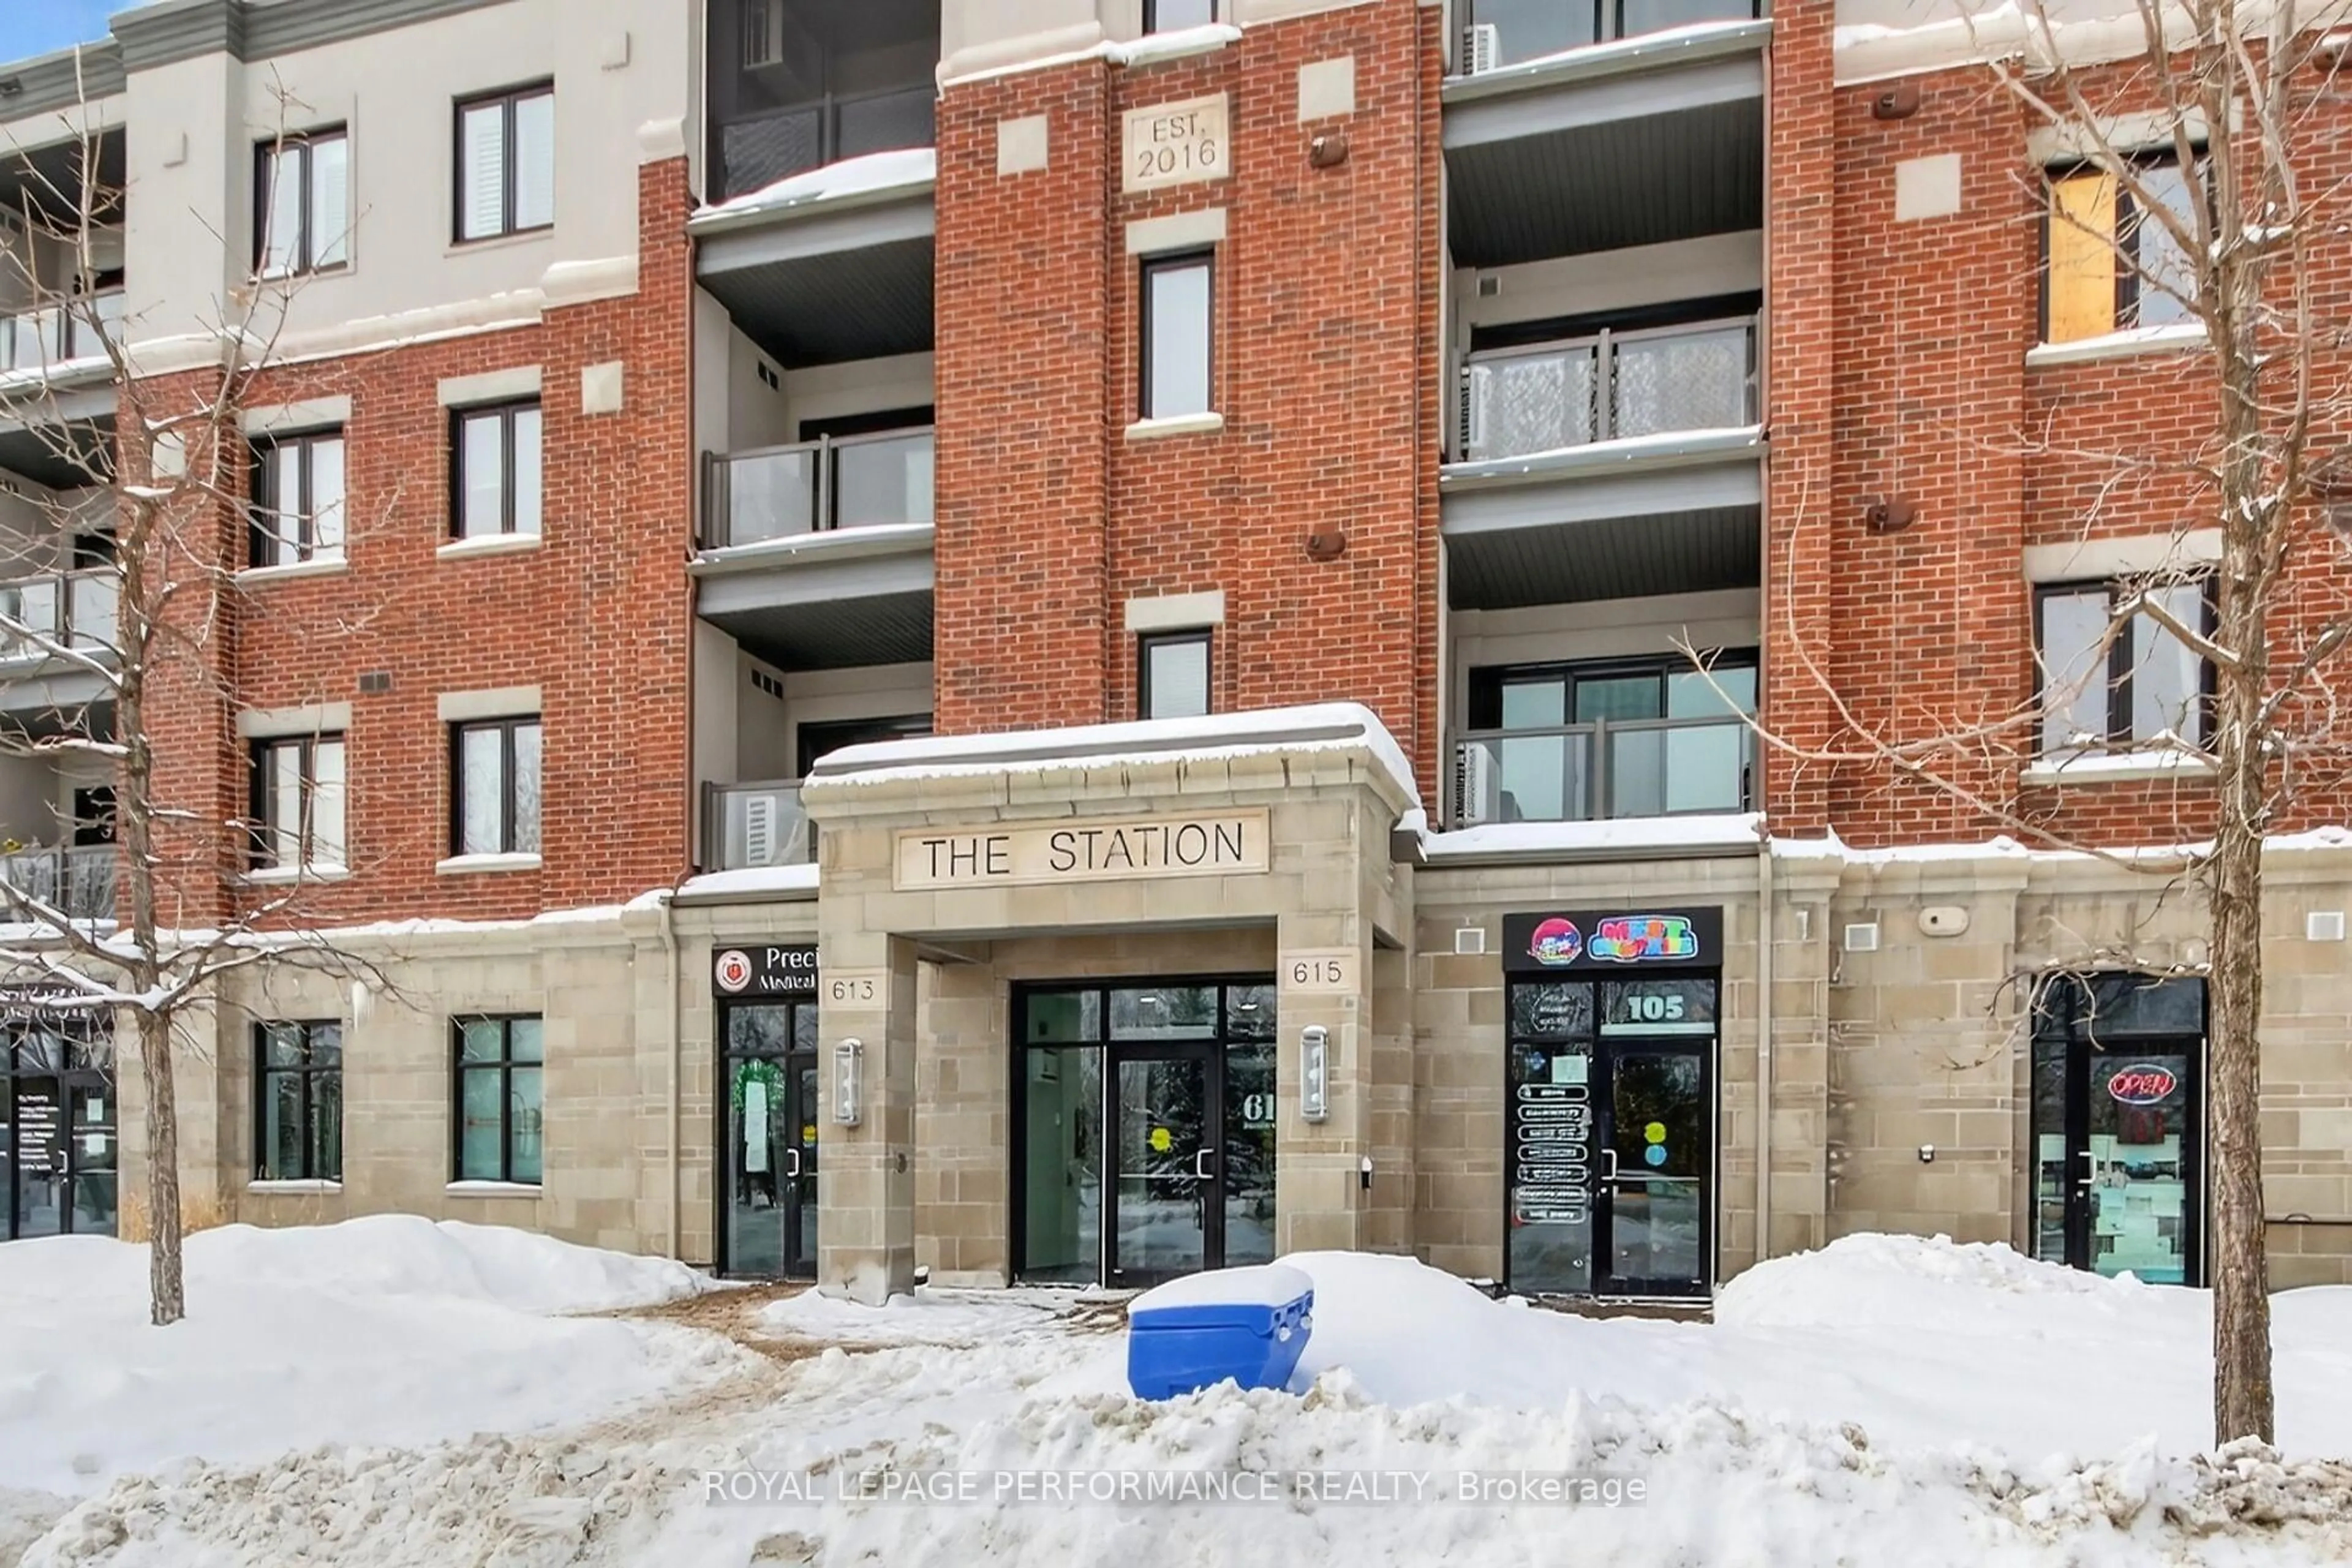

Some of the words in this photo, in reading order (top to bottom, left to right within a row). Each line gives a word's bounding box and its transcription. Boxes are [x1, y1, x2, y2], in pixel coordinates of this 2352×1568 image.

[1153, 113, 1205, 142] EST.
[1138, 139, 1215, 178] 2016
[922, 835, 1010, 877] THE
[1049, 822, 1243, 872] STATION
[1294, 960, 1342, 984] 615
[832, 980, 873, 1000] 613
[1628, 995, 1684, 1020] 105
[2113, 1073, 2171, 1095] OPEN
